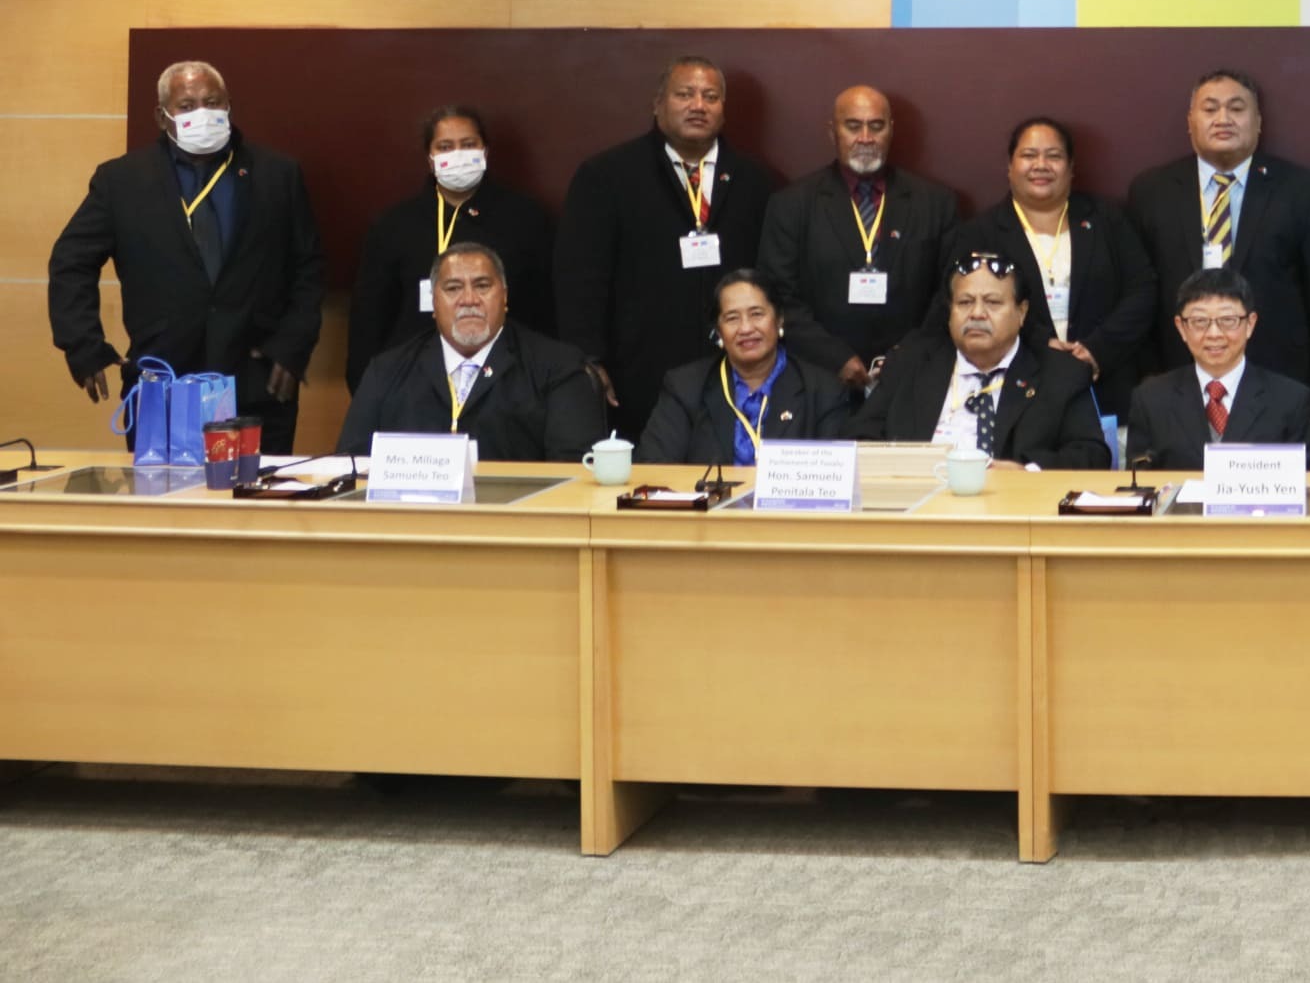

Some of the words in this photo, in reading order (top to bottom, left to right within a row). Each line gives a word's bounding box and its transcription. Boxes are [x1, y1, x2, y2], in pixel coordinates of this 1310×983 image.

[385, 454, 409, 465] Mrs.
[1228, 459, 1282, 471] President
[383, 470, 429, 482] Samuelu
[431, 471, 449, 482] Teo
[767, 470, 792, 482] Hon.
[795, 471, 843, 482] Samuelu
[770, 486, 815, 498] Penitala
[817, 487, 838, 498] Teo
[1215, 482, 1270, 496] Jia-Yush
[1273, 483, 1297, 496] Yen
